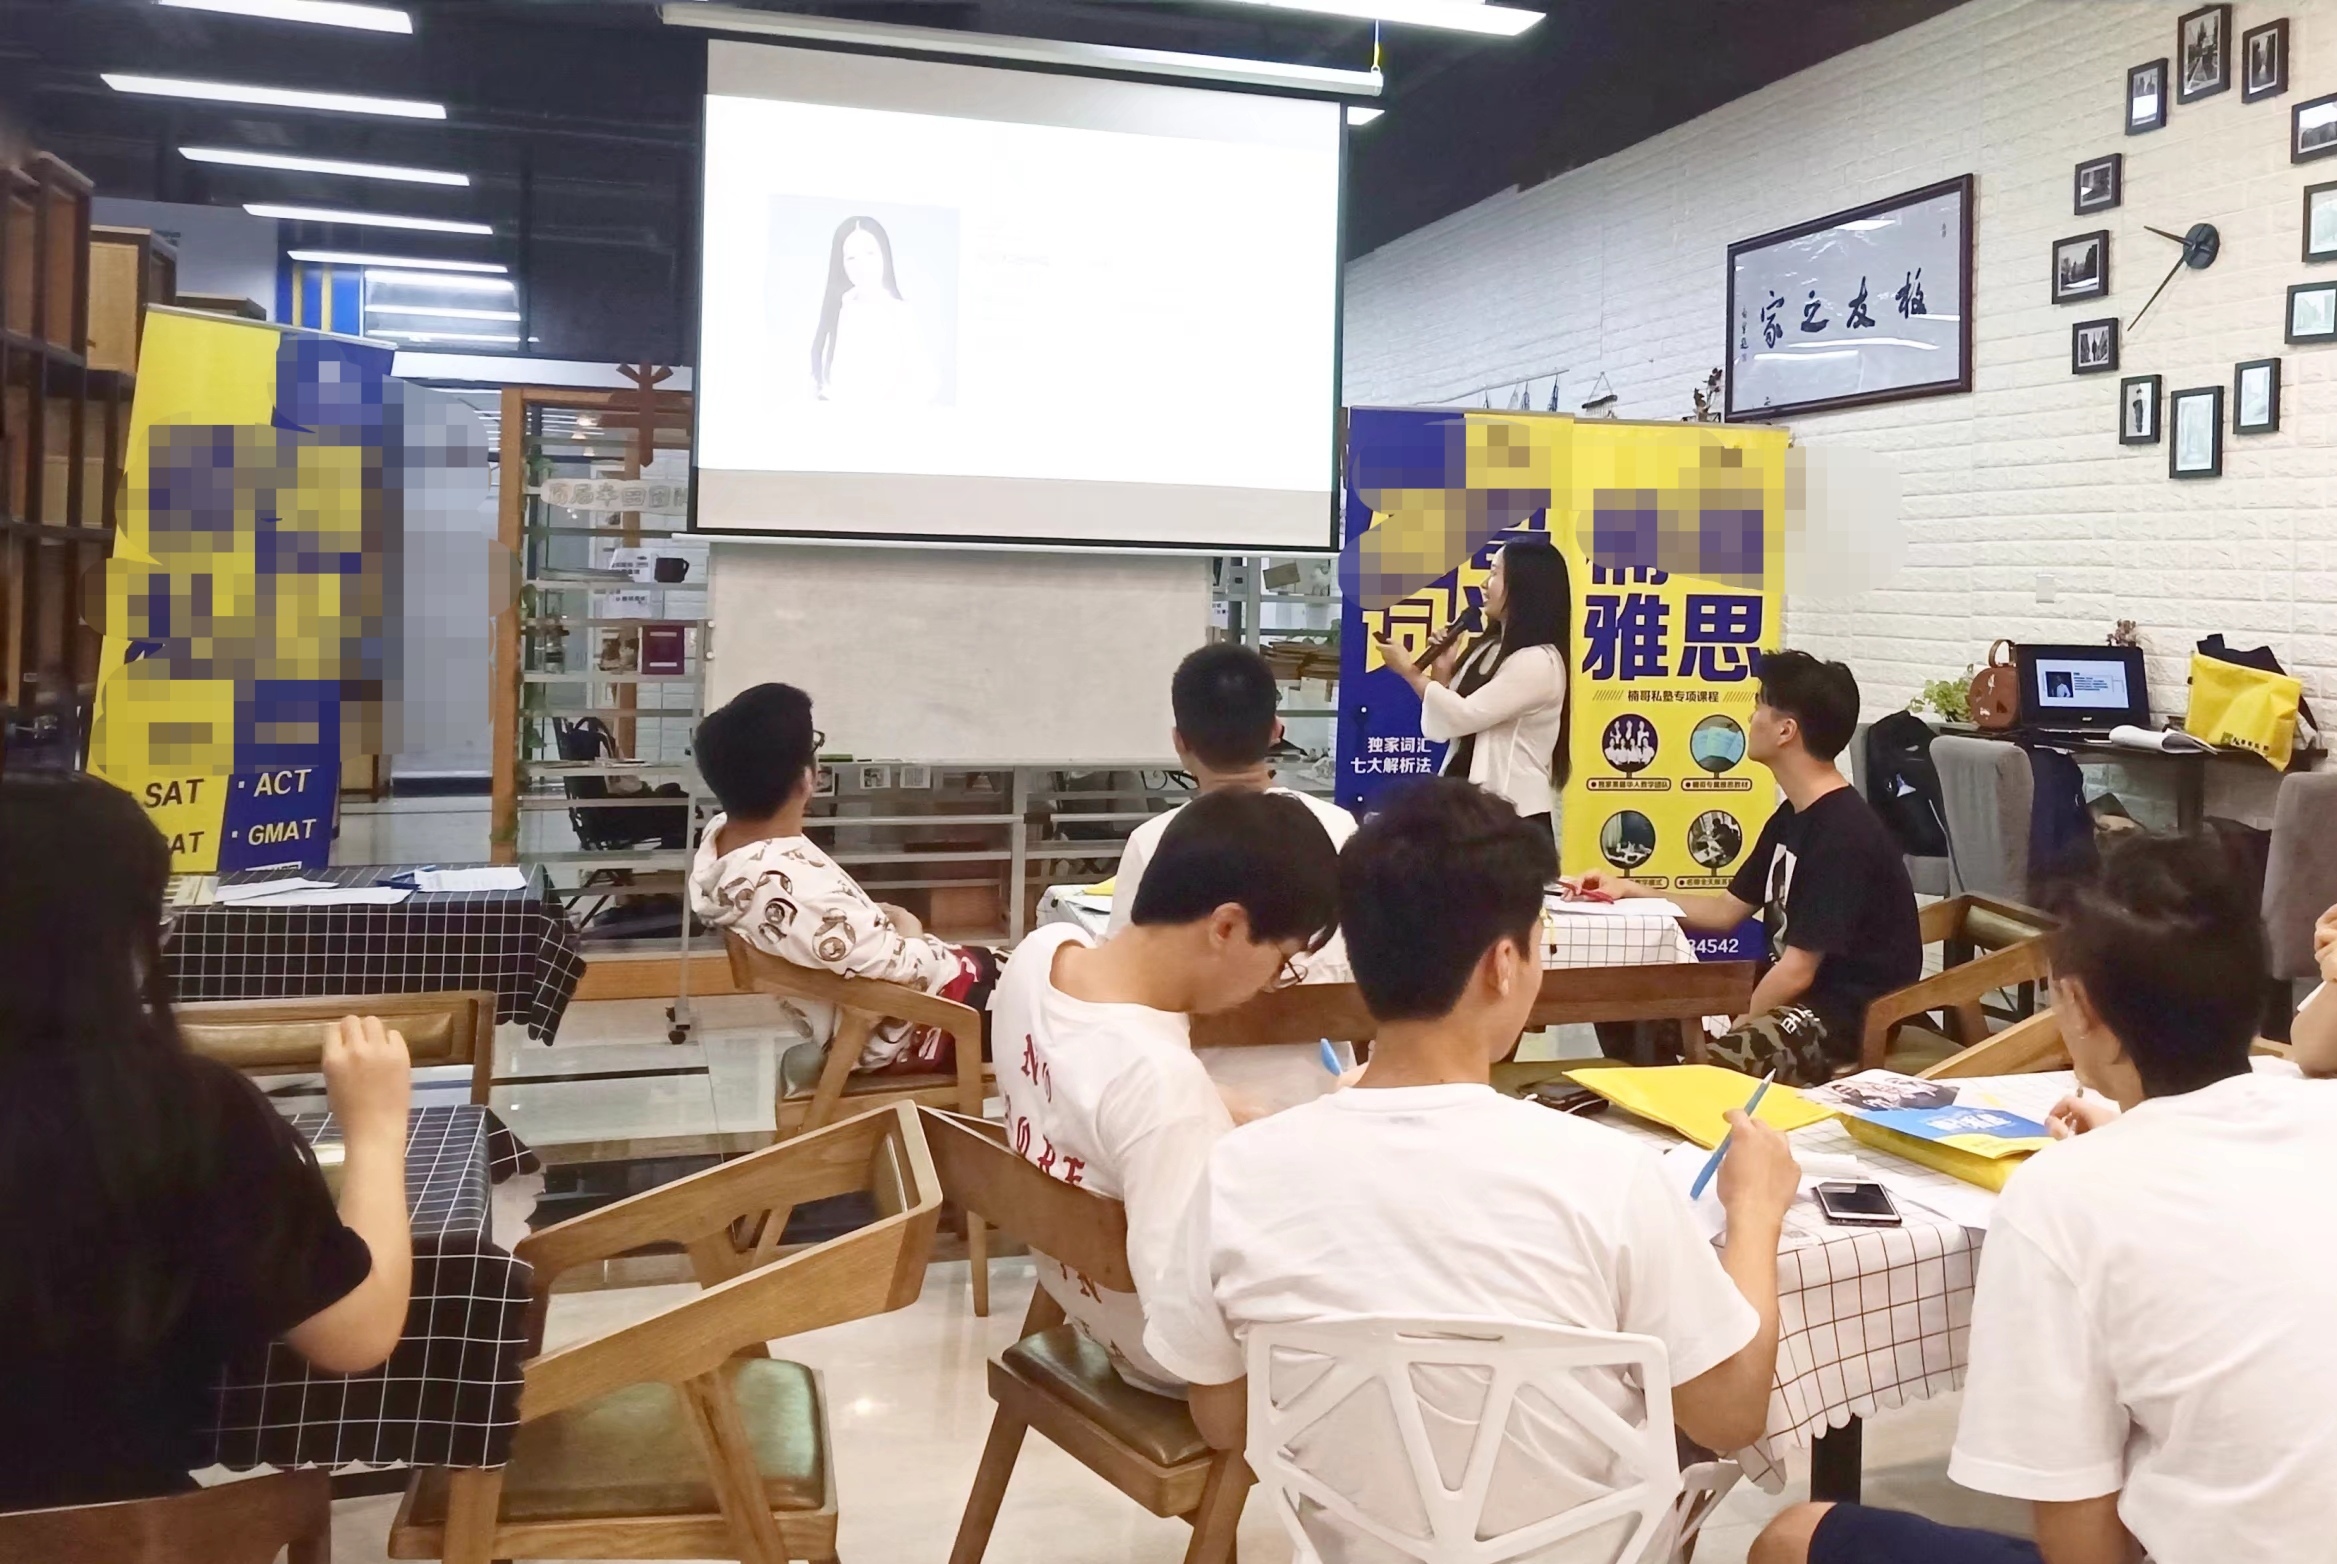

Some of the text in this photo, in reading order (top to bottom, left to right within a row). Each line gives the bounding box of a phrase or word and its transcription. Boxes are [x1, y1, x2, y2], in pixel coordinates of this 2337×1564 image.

[1582, 593, 1764, 682] 雅思
[1627, 689, 1720, 704] 楠哥私塾专项课程
[1367, 736, 1432, 753] 独家词汇
[1350, 757, 1432, 774] 七大解析法
[145, 779, 204, 808] SAT
[254, 769, 311, 796] ACT
[170, 831, 204, 854] AT
[249, 819, 316, 845] GMAT
